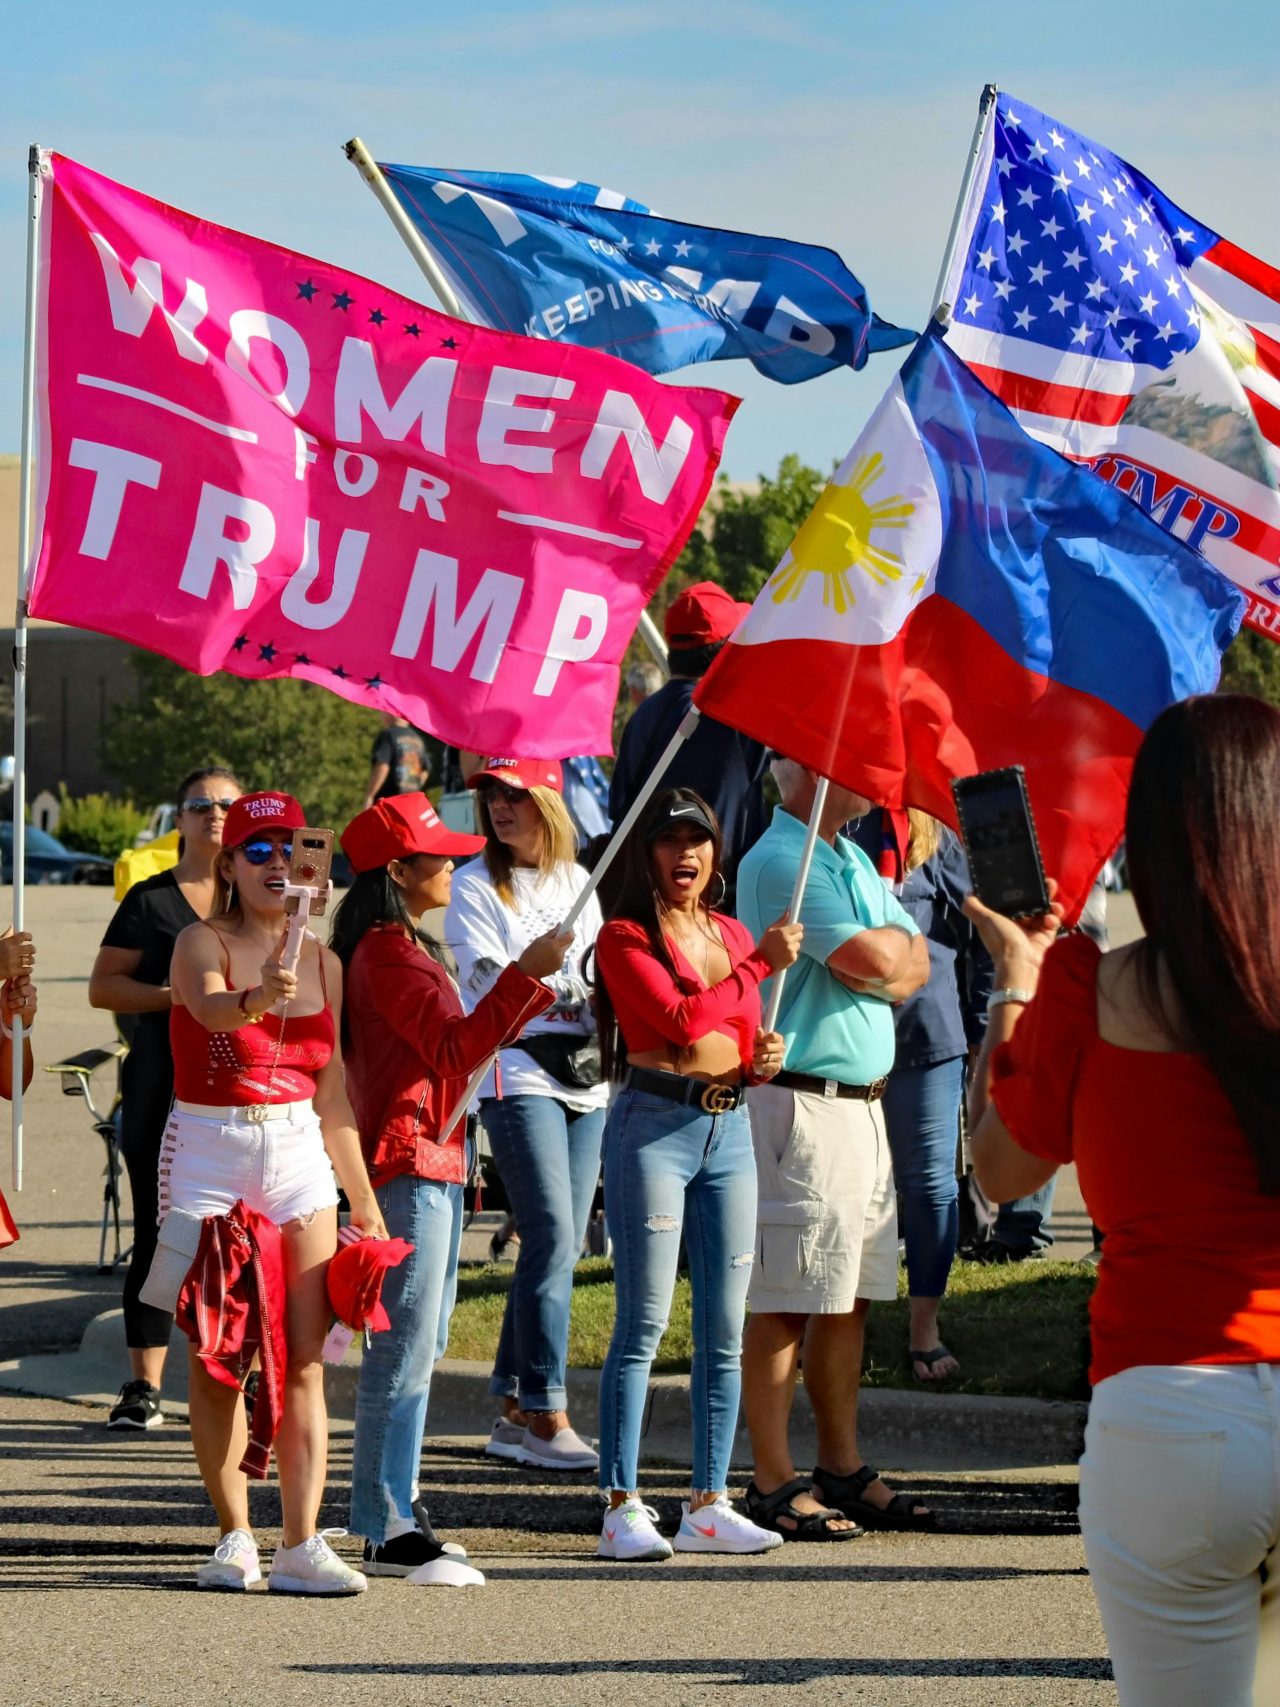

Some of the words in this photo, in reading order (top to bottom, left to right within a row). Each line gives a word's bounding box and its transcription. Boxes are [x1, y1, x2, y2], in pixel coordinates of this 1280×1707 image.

[524, 280, 664, 341] KEEPING
[88, 231, 695, 505] WOMEN
[294, 428, 451, 523] FOR
[67, 437, 608, 698] TRUMP
[243, 797, 287, 811] TRUMP
[250, 808, 286, 818] GIRL
